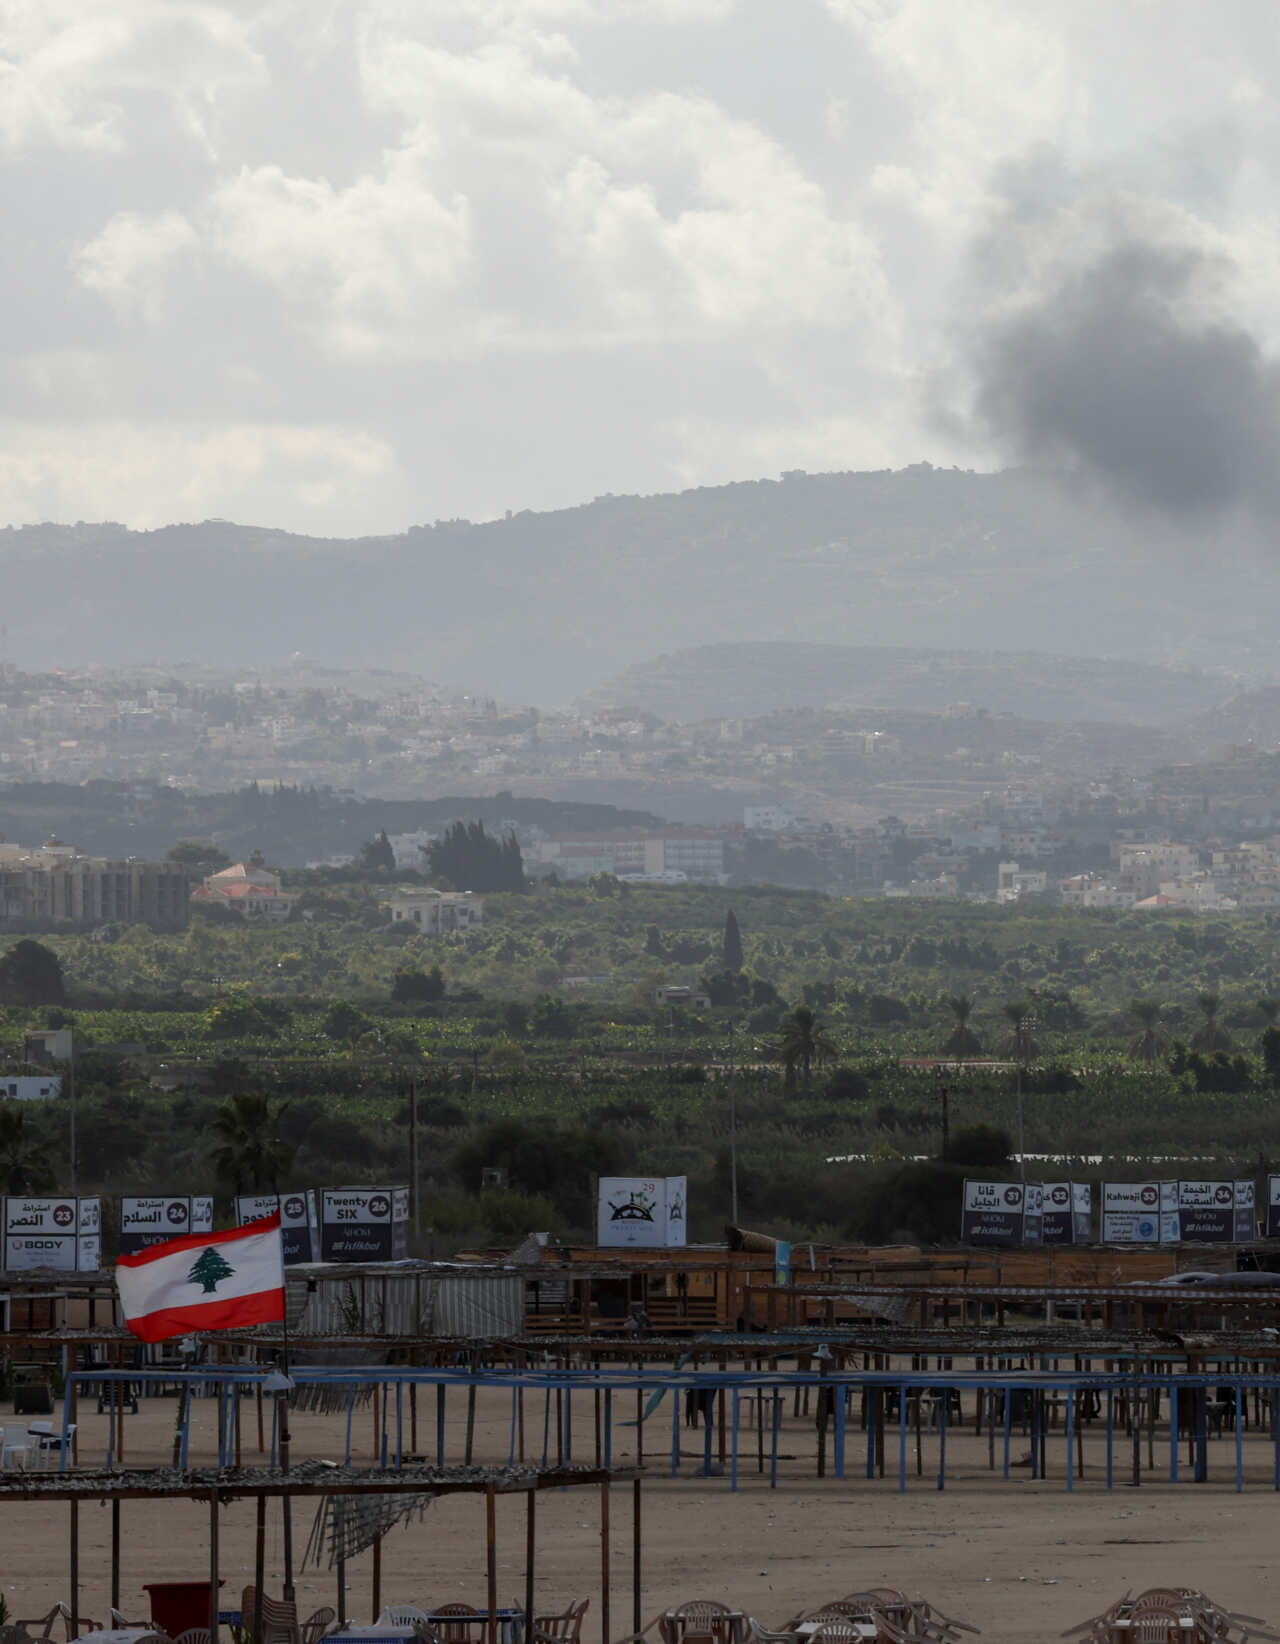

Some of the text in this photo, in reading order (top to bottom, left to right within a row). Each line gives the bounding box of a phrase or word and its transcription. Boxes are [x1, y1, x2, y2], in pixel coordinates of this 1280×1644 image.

[643, 1183, 656, 1193] 29
[1183, 1183, 1211, 1197] الخيمة
[1007, 1191, 1019, 1200] 31
[1053, 1191, 1067, 1201] 32
[1106, 1191, 1140, 1203] Kahwaji
[1143, 1192, 1155, 1201] 33
[1216, 1190, 1230, 1200] 34
[325, 1196, 368, 1208] Twenty
[371, 1201, 387, 1212] 26
[970, 1196, 1000, 1210] الجليل
[1180, 1195, 1216, 1208] السعيدة
[287, 1203, 303, 1213] 25
[56, 1211, 71, 1221] 23
[169, 1208, 185, 1219] 24
[336, 1209, 358, 1219] SIX
[9, 1214, 43, 1229] النصر
[123, 1211, 161, 1228] السلام
[25, 1240, 63, 1249] BODY
